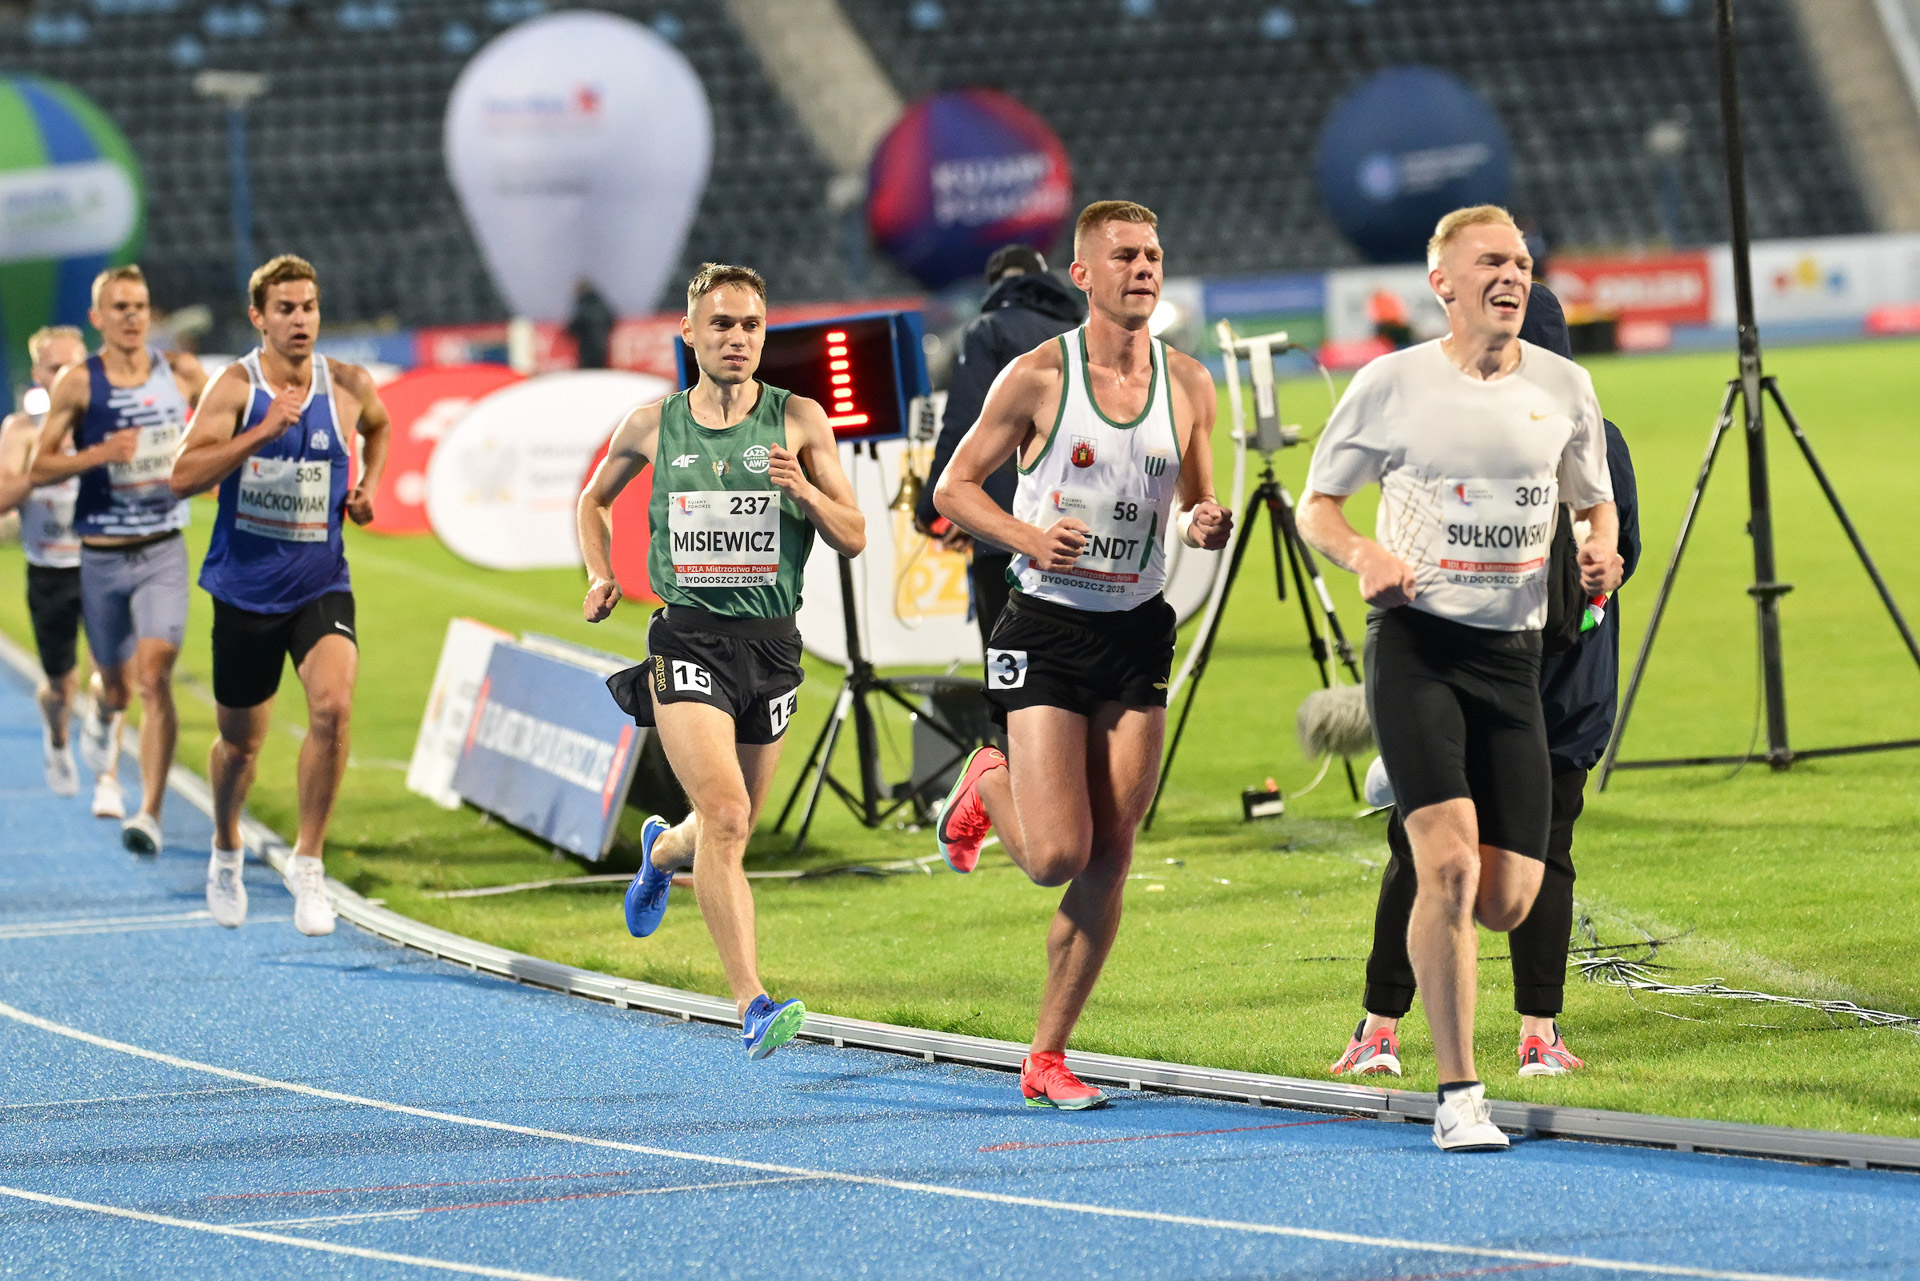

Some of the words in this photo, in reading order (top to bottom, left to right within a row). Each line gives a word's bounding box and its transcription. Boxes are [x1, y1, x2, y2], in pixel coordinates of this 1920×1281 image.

[671, 454, 700, 468] 4F
[749, 449, 766, 457] AZS
[748, 459, 770, 468] AWF
[295, 467, 322, 482] 505
[241, 488, 326, 513] MAĆKOWIAK
[1515, 485, 1551, 506] 301
[730, 496, 770, 515] 237
[1113, 501, 1138, 522] 58
[674, 531, 775, 552] MISIEWICZ
[1447, 521, 1548, 549] SUŁKOWSKI
[1082, 533, 1139, 560] ENDT
[706, 565, 750, 573] Mistrzostwa
[752, 565, 773, 573] Polski
[685, 576, 739, 584] BYDGOSZCZ
[741, 575, 764, 584] 2025
[1040, 574, 1104, 592] BYDGOSZCZ
[1106, 585, 1125, 593] 2025
[1454, 574, 1519, 585] BYDGOSZCZ
[675, 665, 710, 689] 15
[996, 653, 1020, 685] 3
